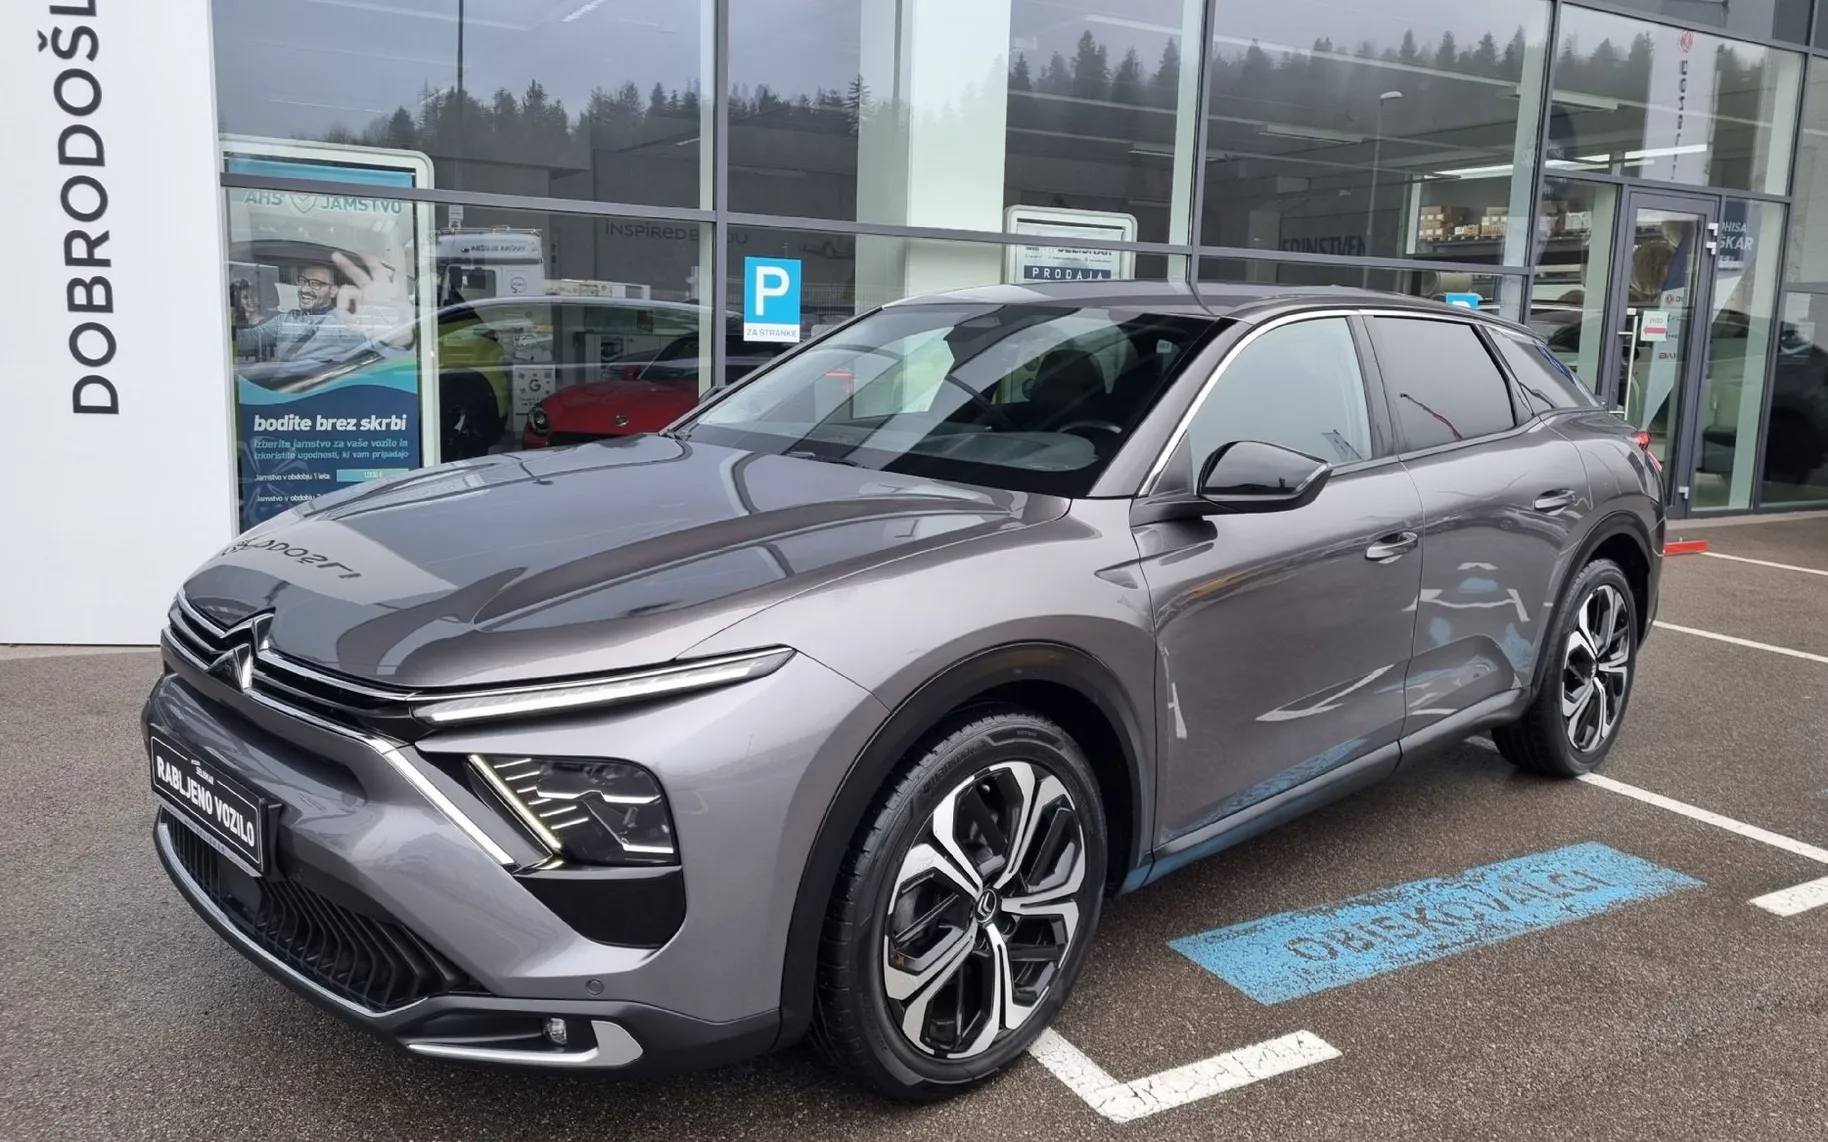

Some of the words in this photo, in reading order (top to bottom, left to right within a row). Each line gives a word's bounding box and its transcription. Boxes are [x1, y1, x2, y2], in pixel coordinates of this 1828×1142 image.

[321, 197, 403, 215] JAMSTVO
[1032, 267, 1104, 280] PRODAJA
[755, 265, 790, 316] P
[747, 328, 758, 336] ZA
[759, 329, 797, 338] STRANKE
[254, 414, 312, 431] bodite
[315, 414, 357, 431] brez
[360, 413, 407, 431] skrbi
[292, 439, 331, 450] jamstvo
[333, 440, 345, 448] za
[347, 438, 369, 448] vaše
[371, 438, 397, 448] vozilo
[399, 438, 408, 448] in
[352, 451, 370, 459] vam
[372, 450, 409, 460] pripadajo
[256, 473, 282, 481] Jamstvo
[288, 473, 313, 481] obdobju
[257, 494, 283, 502] Jamstvo
[156, 755, 213, 815] RABLJENO
[214, 796, 255, 847] VOZILO
